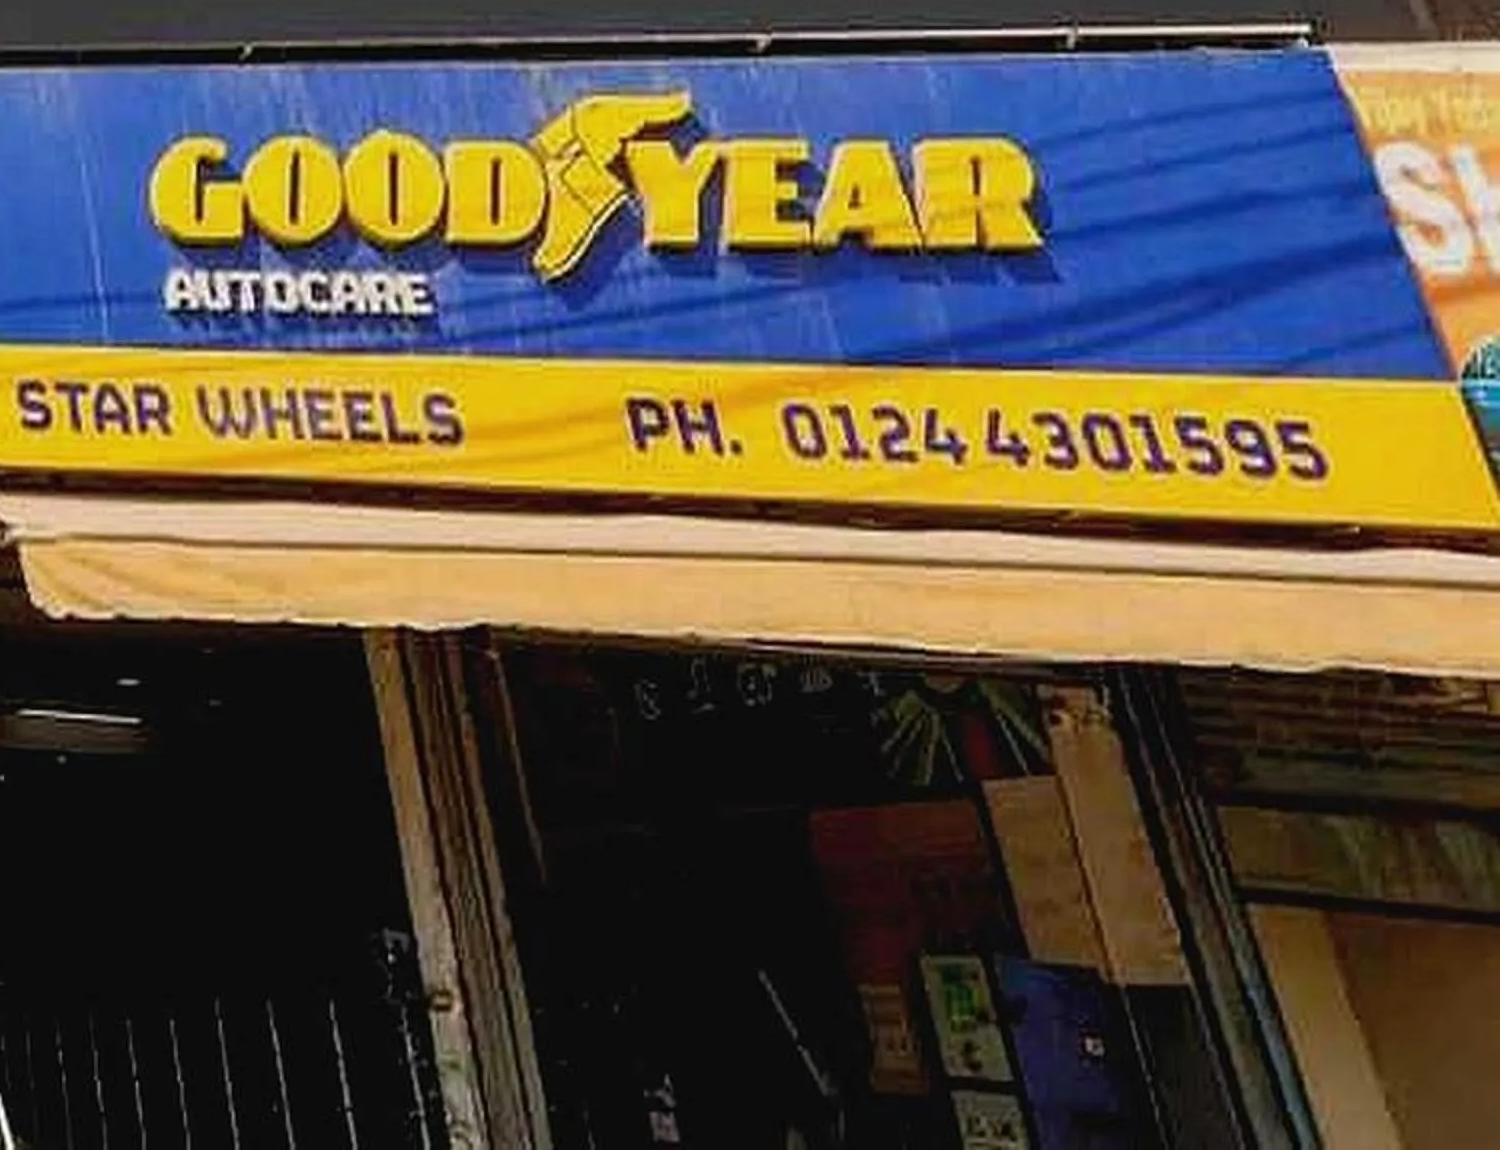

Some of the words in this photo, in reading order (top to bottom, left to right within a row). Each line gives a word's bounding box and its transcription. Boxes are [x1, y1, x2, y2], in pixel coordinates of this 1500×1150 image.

[164, 270, 434, 318] AUTOCARE
[16, 381, 173, 436] STAR
[198, 390, 465, 447] WHEELS
[626, 398, 743, 456] PH.
